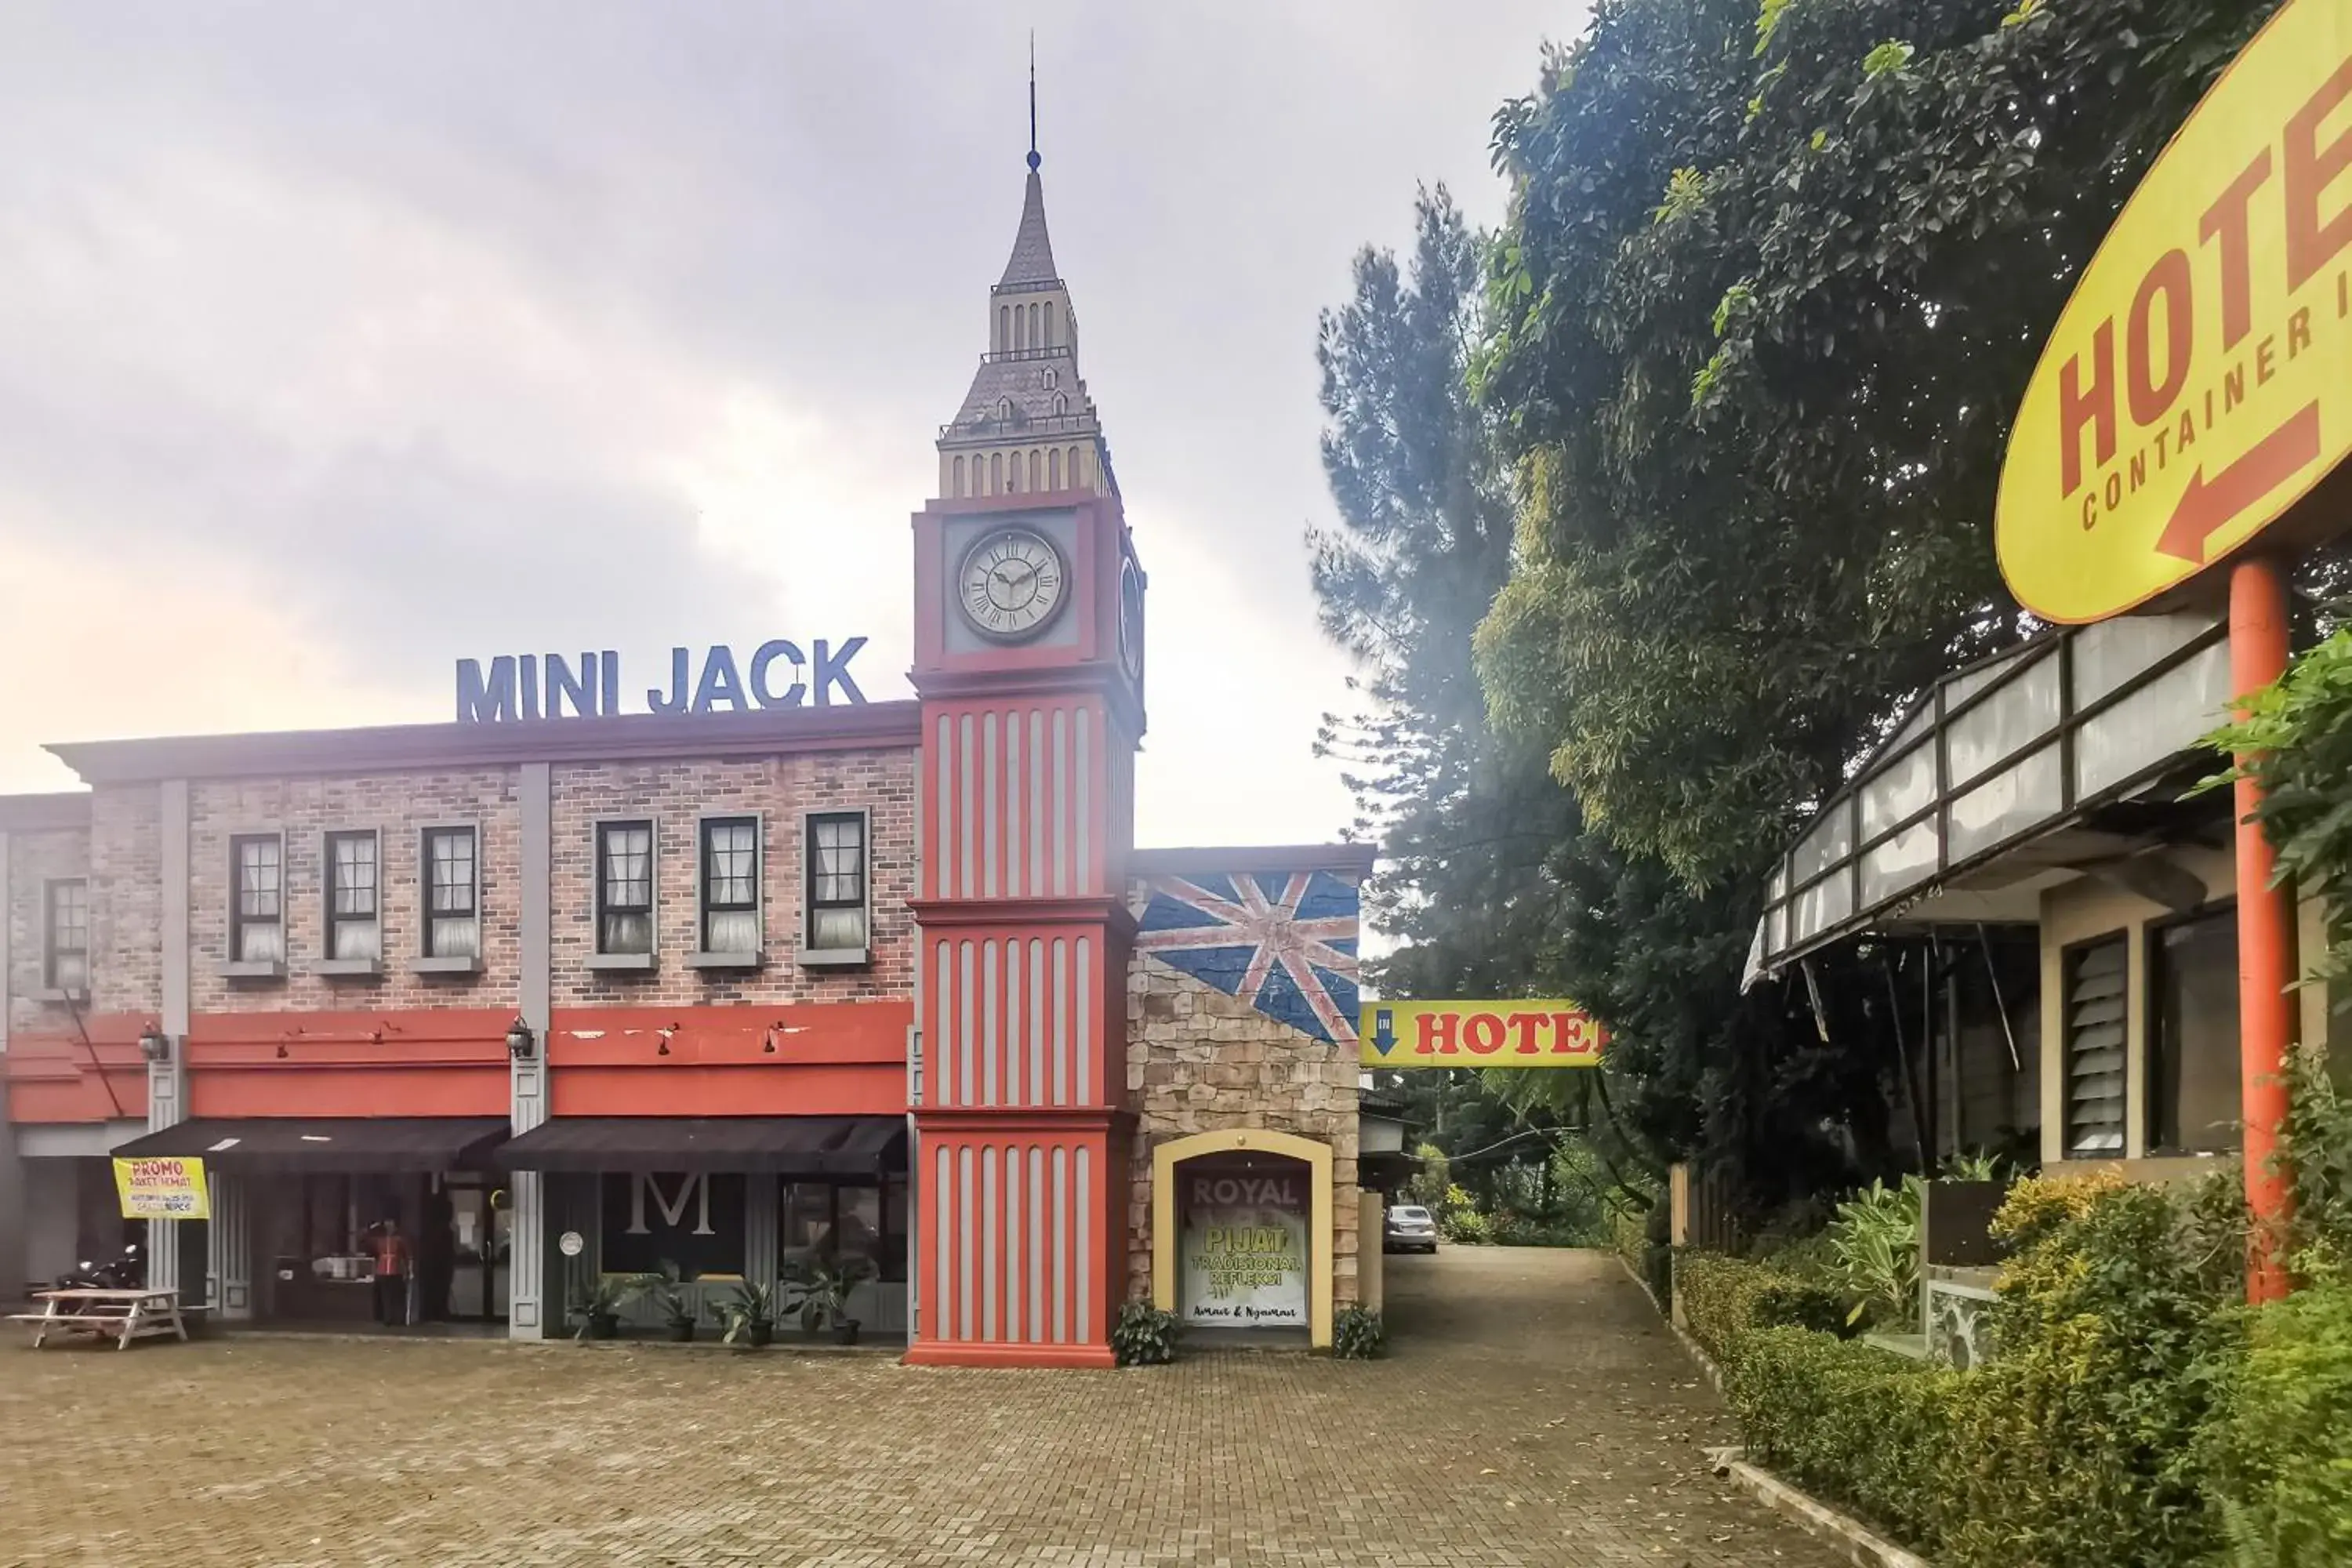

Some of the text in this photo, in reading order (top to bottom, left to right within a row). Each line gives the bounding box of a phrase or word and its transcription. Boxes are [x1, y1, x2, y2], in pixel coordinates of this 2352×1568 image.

[2082, 305, 2310, 532] CONTAINER
[456, 637, 869, 725] MINI JACK
[1378, 1018, 1390, 1029] IN
[132, 1161, 183, 1175] PROMO
[1193, 1178, 1298, 1204] ROYAL
[1204, 1226, 1287, 1254] PIJAT
[1210, 1272, 1283, 1286] REFLEKSI
